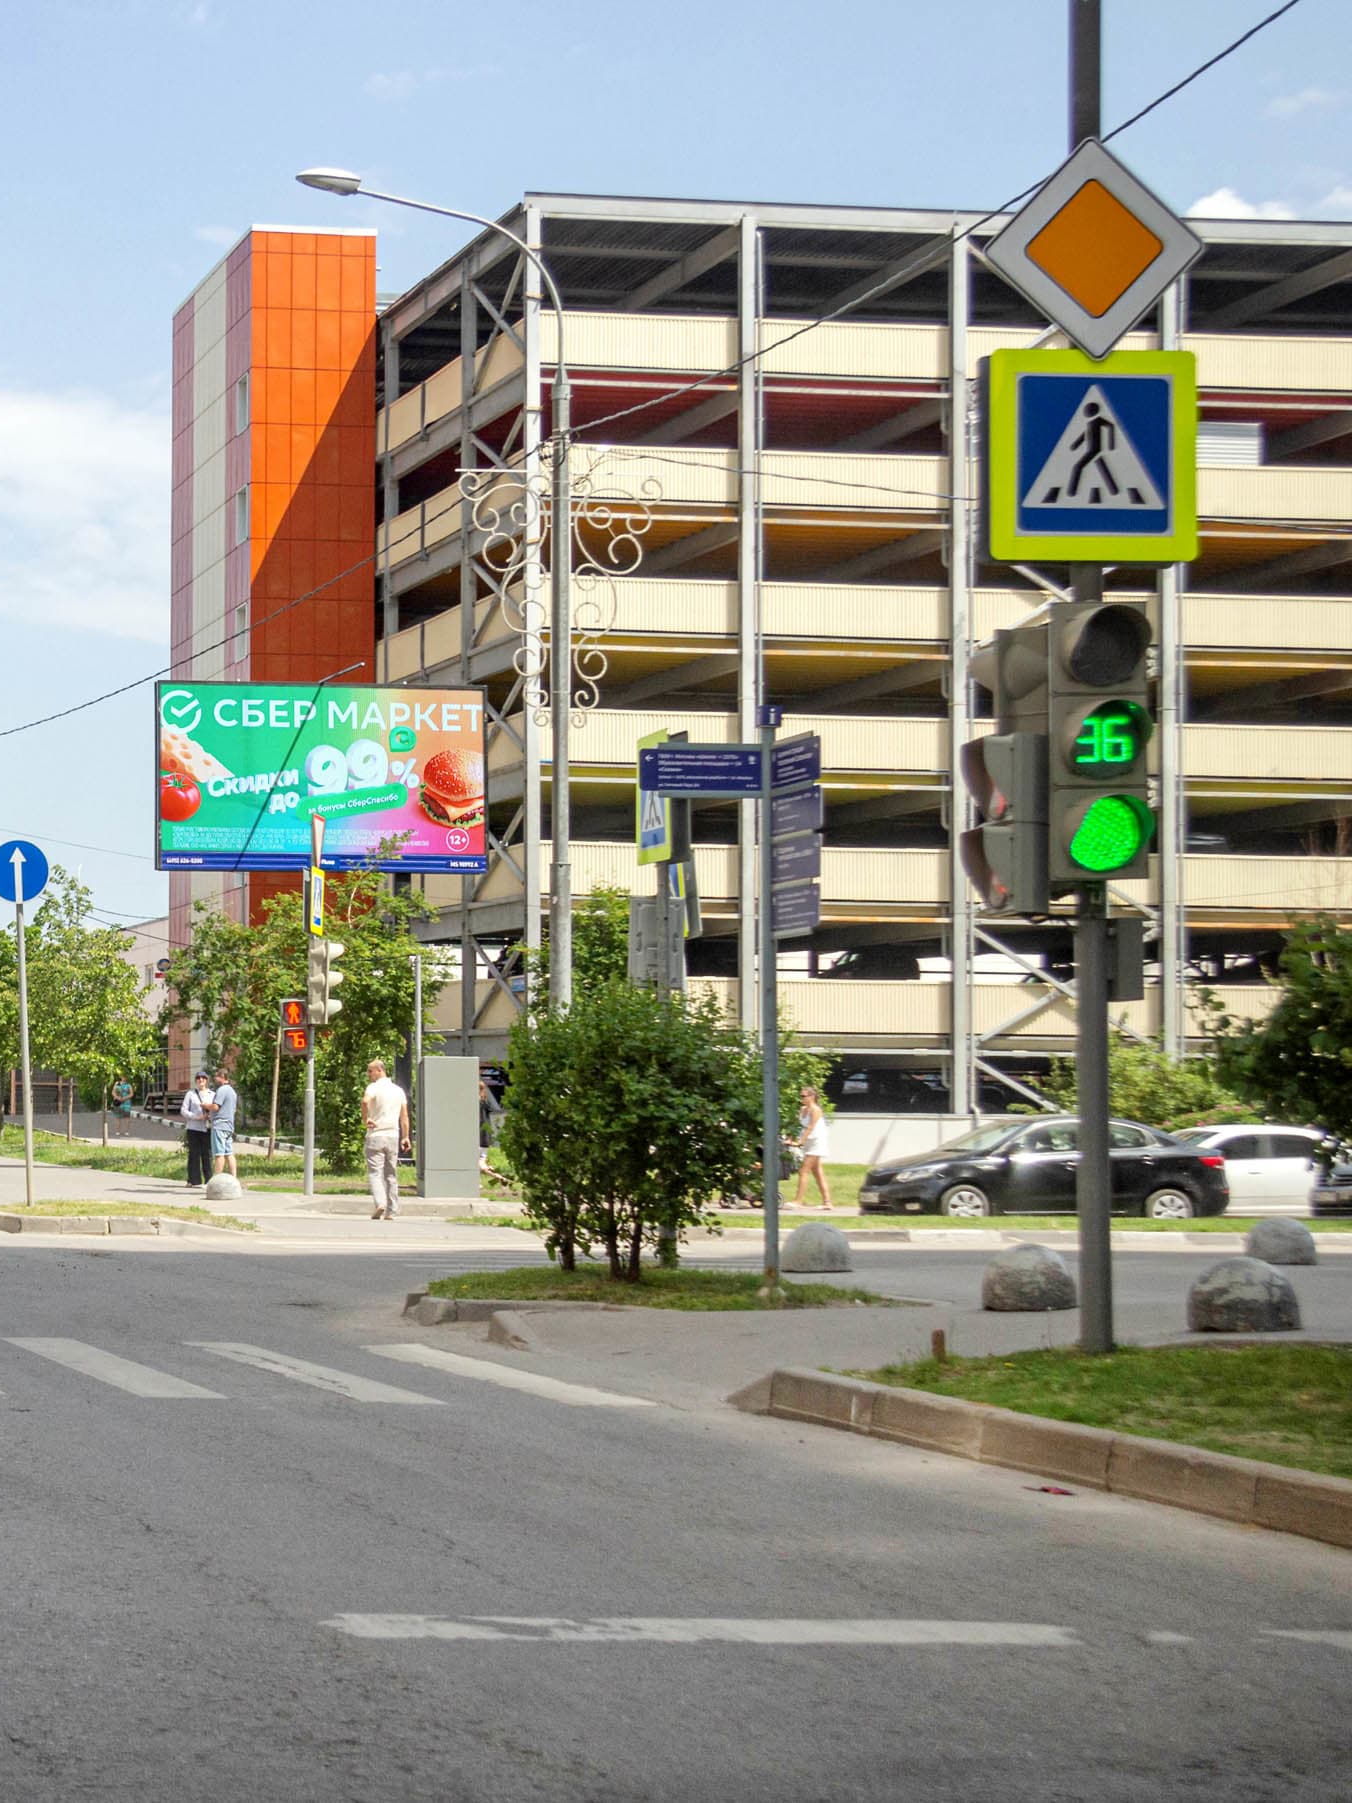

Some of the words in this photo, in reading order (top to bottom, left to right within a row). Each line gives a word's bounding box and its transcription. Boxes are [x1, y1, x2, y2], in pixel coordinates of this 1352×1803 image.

[214, 699, 316, 728] СБЕР
[328, 701, 482, 732] МАРКЕТ
[1076, 716, 1134, 763] 36
[208, 769, 299, 797] Скидки
[269, 791, 300, 815] до
[449, 834, 468, 846] 12+
[288, 1031, 306, 1048] 76
